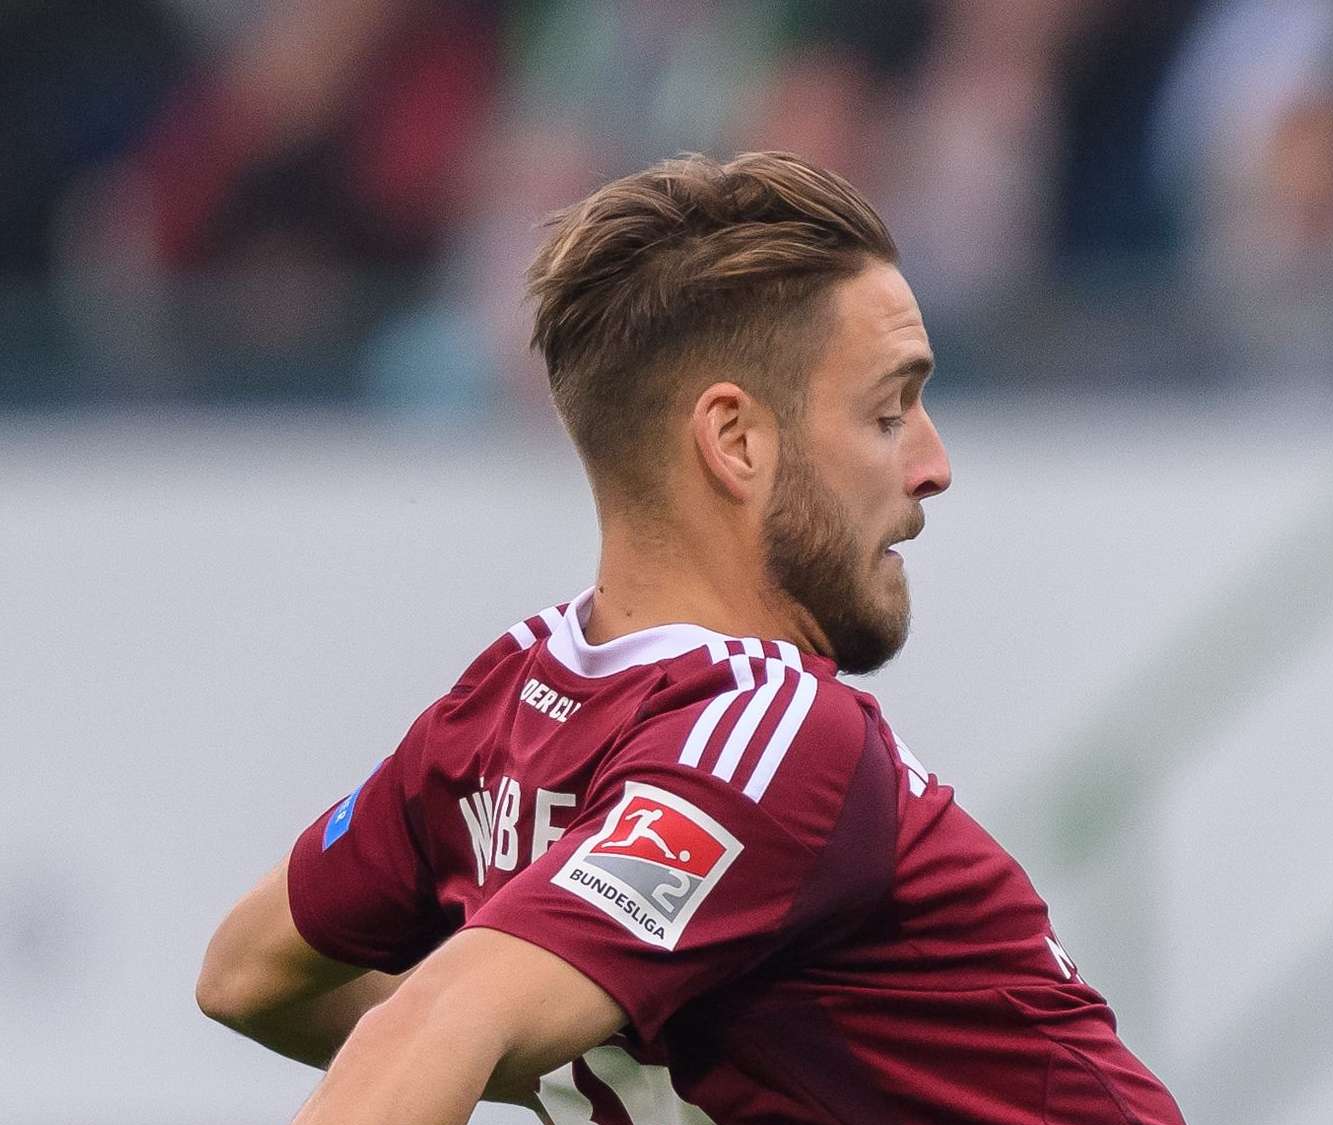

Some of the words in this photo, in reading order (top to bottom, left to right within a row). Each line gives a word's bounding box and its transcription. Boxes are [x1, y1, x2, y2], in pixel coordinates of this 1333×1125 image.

[520, 678, 558, 713] DER
[569, 868, 665, 940] BUNDESLIGA
[652, 870, 691, 913] 2
